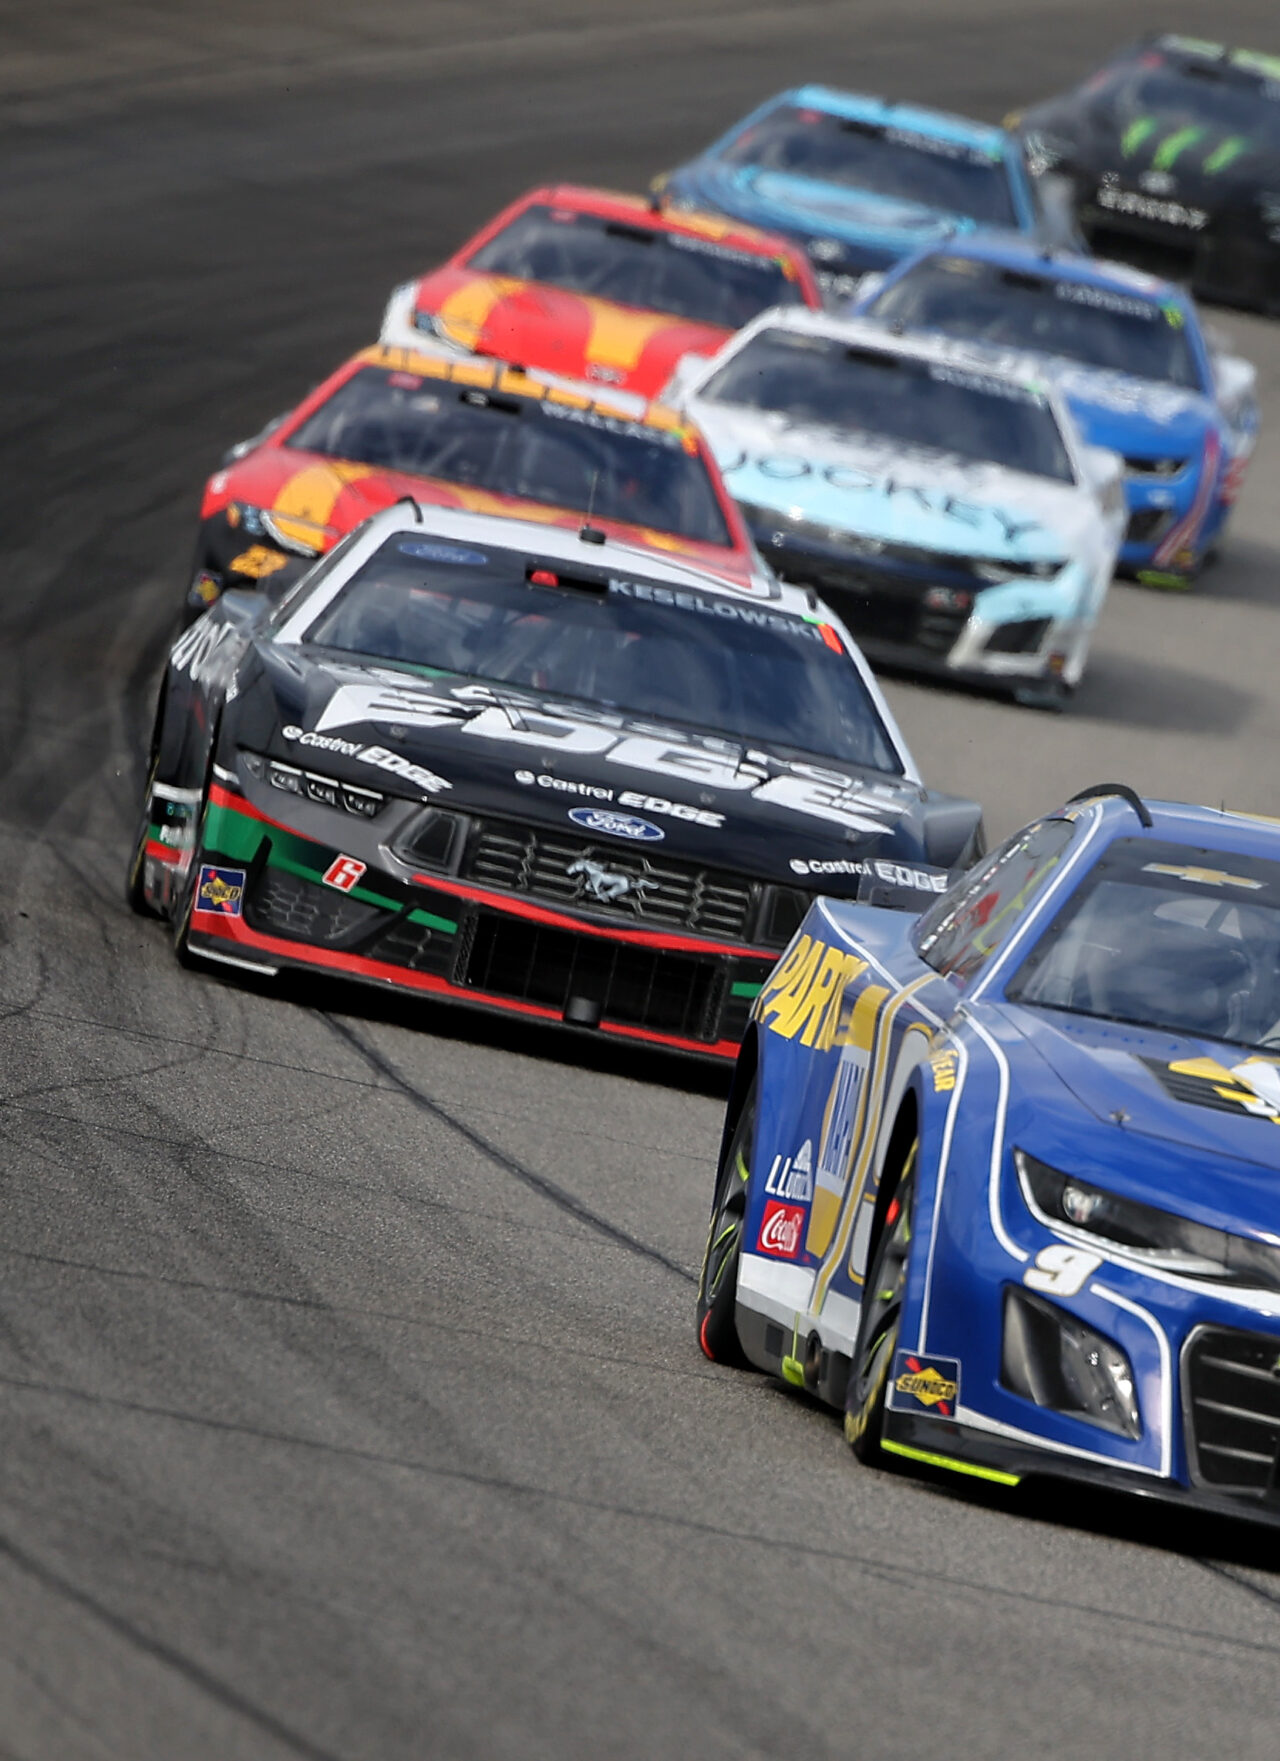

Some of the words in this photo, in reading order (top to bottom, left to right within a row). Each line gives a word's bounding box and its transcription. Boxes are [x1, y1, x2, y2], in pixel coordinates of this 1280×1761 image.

[608, 578, 823, 641] KESELOWSKI
[300, 732, 363, 757] Castrol
[356, 745, 453, 793] EDGE
[314, 685, 905, 836] EDGE
[537, 774, 613, 801] Castrol
[618, 791, 726, 828] EDGE
[582, 809, 652, 838] Ford
[322, 853, 367, 892] 6
[808, 859, 873, 876] Castrol
[873, 862, 949, 893] EDGE
[1023, 1244, 1104, 1297] 9
[896, 1373, 957, 1399] SUNOCO
